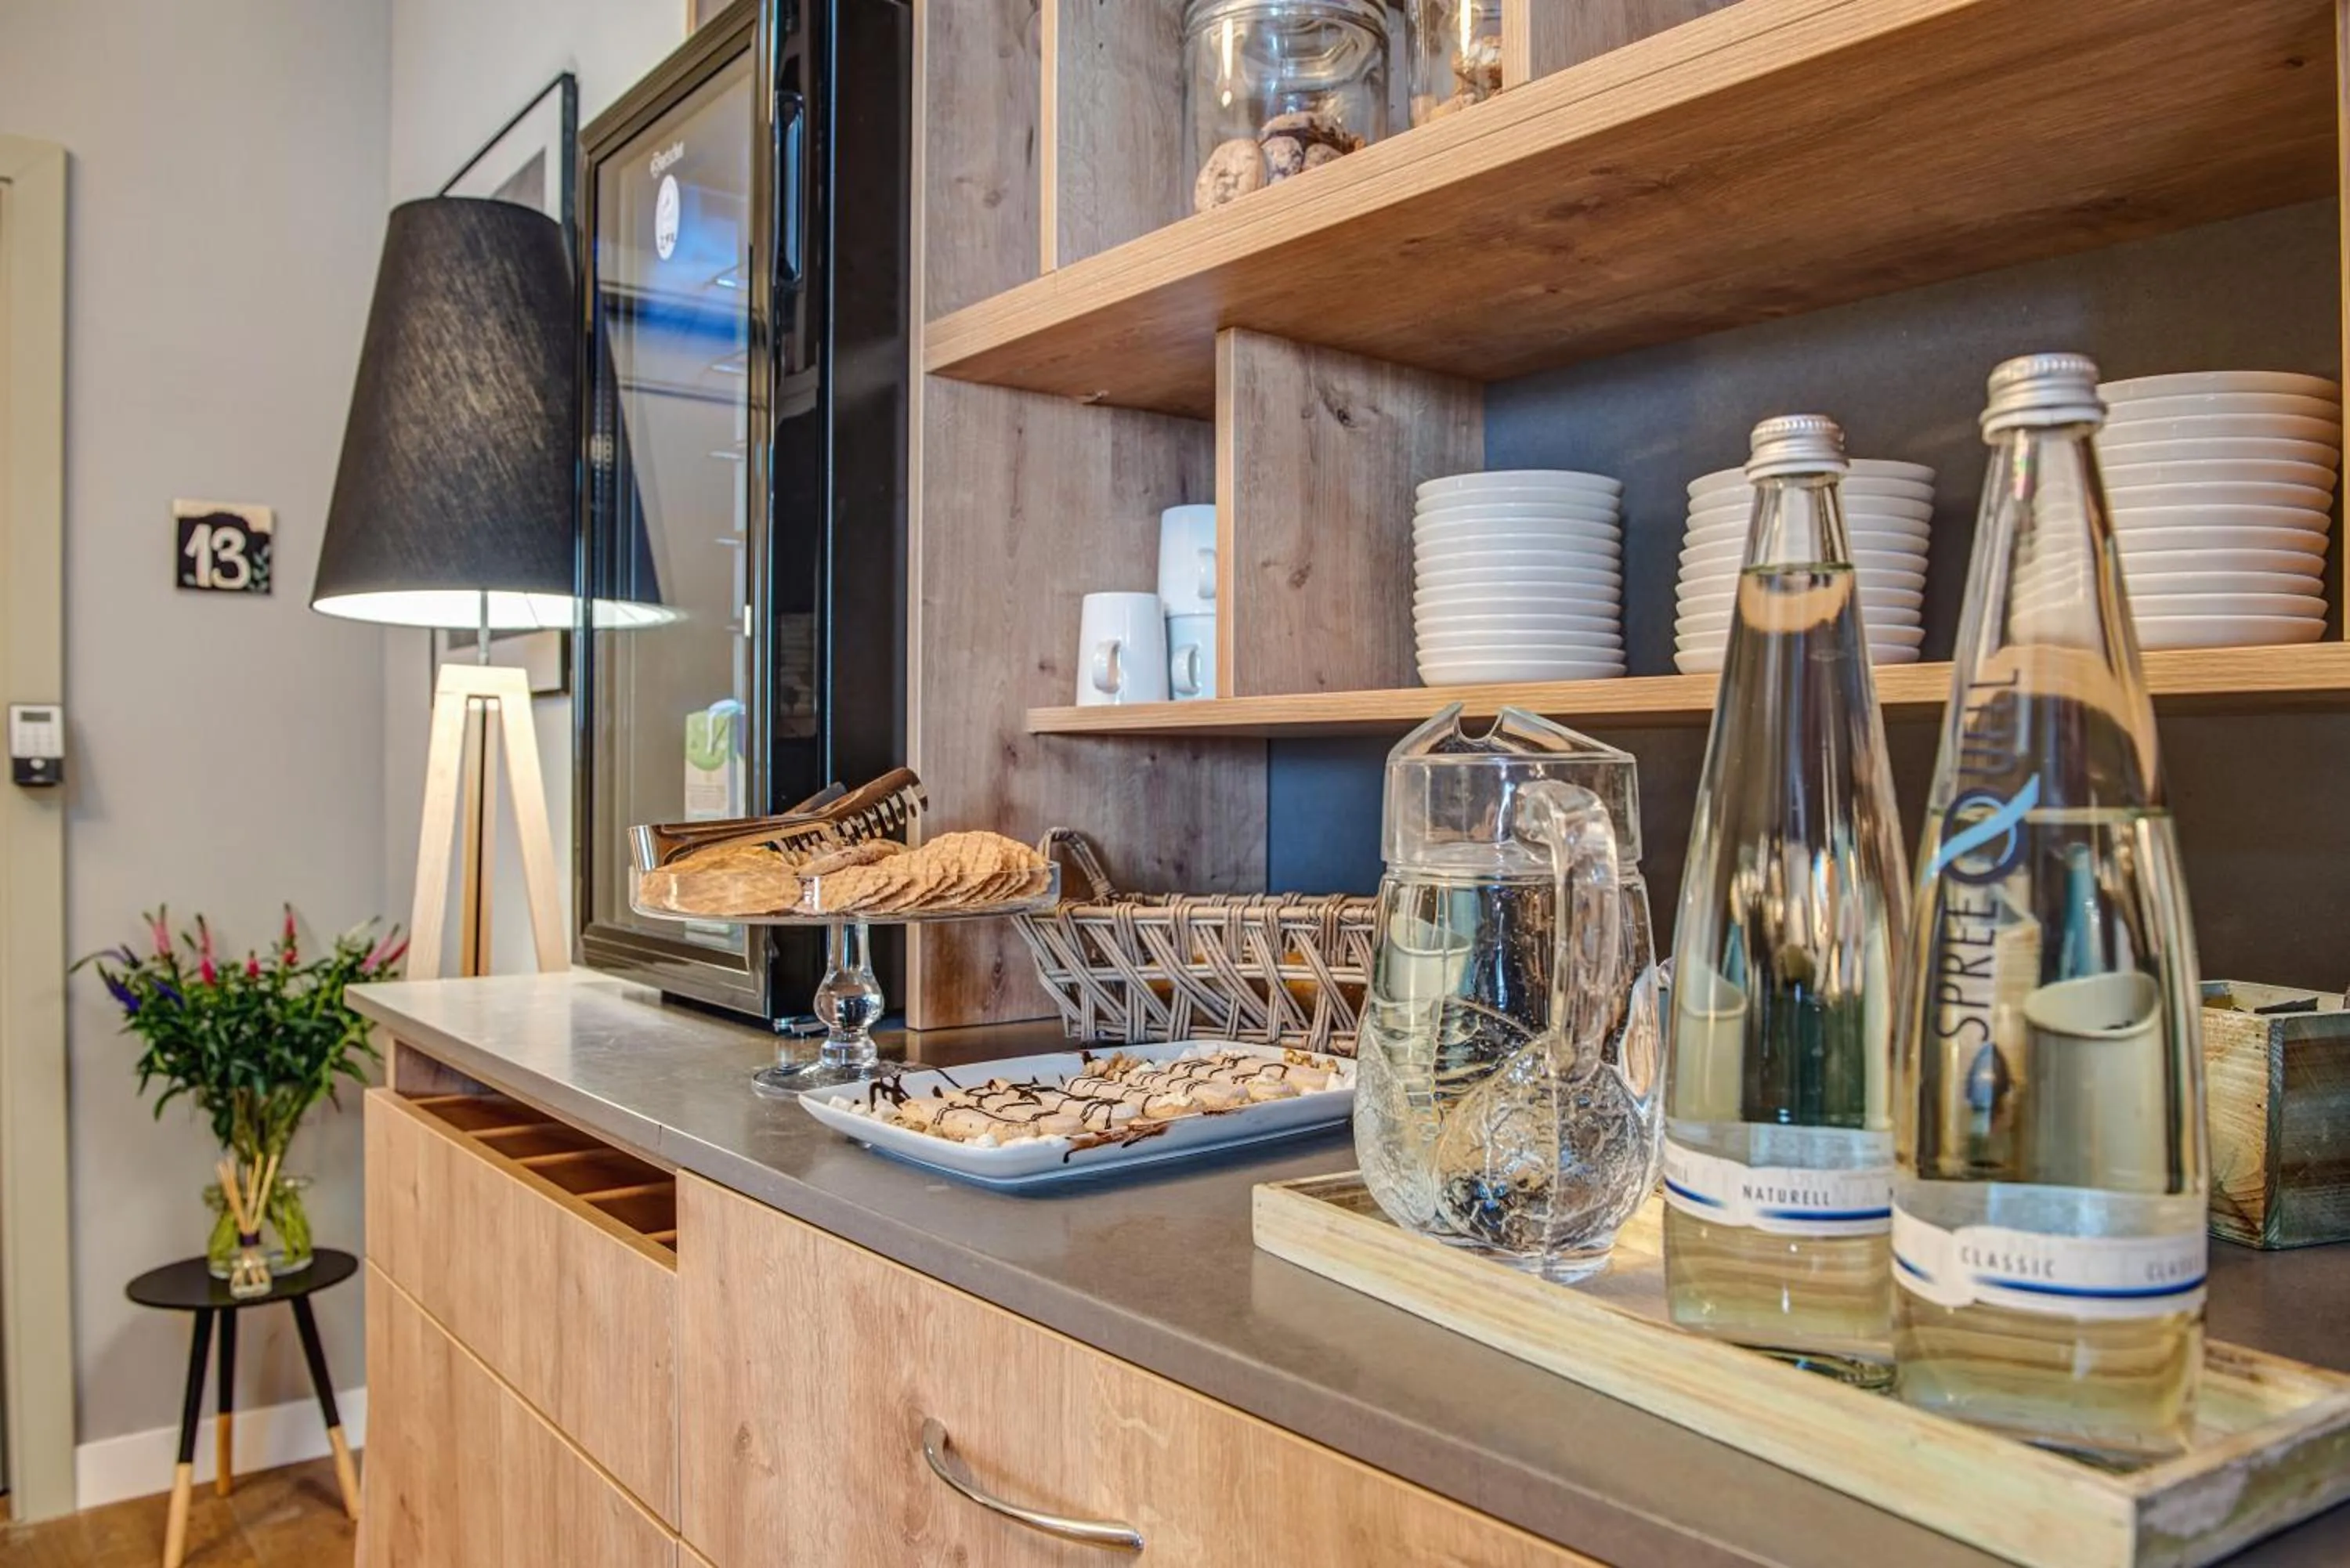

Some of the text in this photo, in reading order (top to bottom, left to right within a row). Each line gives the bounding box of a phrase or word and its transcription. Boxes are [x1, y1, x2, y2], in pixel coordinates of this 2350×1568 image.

[184, 522, 251, 589] 13
[1742, 1184, 1831, 1207] NATURELL
[1961, 1245, 2056, 1279] CLASSIC
